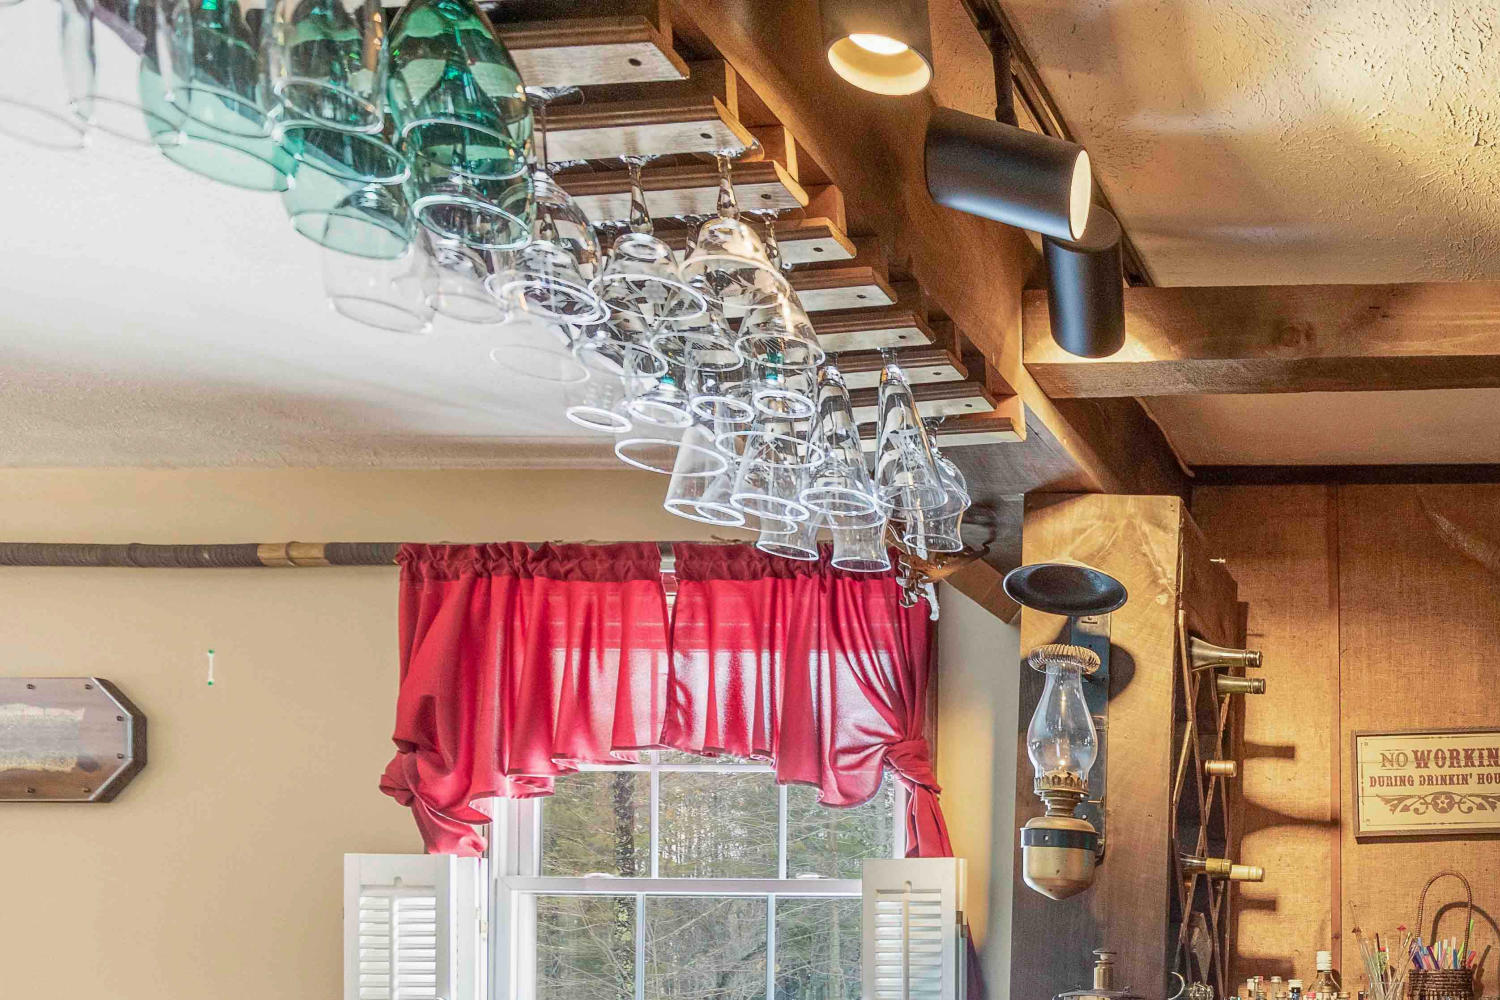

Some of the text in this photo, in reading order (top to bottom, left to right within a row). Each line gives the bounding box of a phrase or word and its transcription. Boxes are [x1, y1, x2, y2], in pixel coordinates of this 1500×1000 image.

[1380, 752, 1409, 769] NO
[1369, 775, 1415, 788] DURING
[1419, 772, 1473, 786] DRINKIN'
